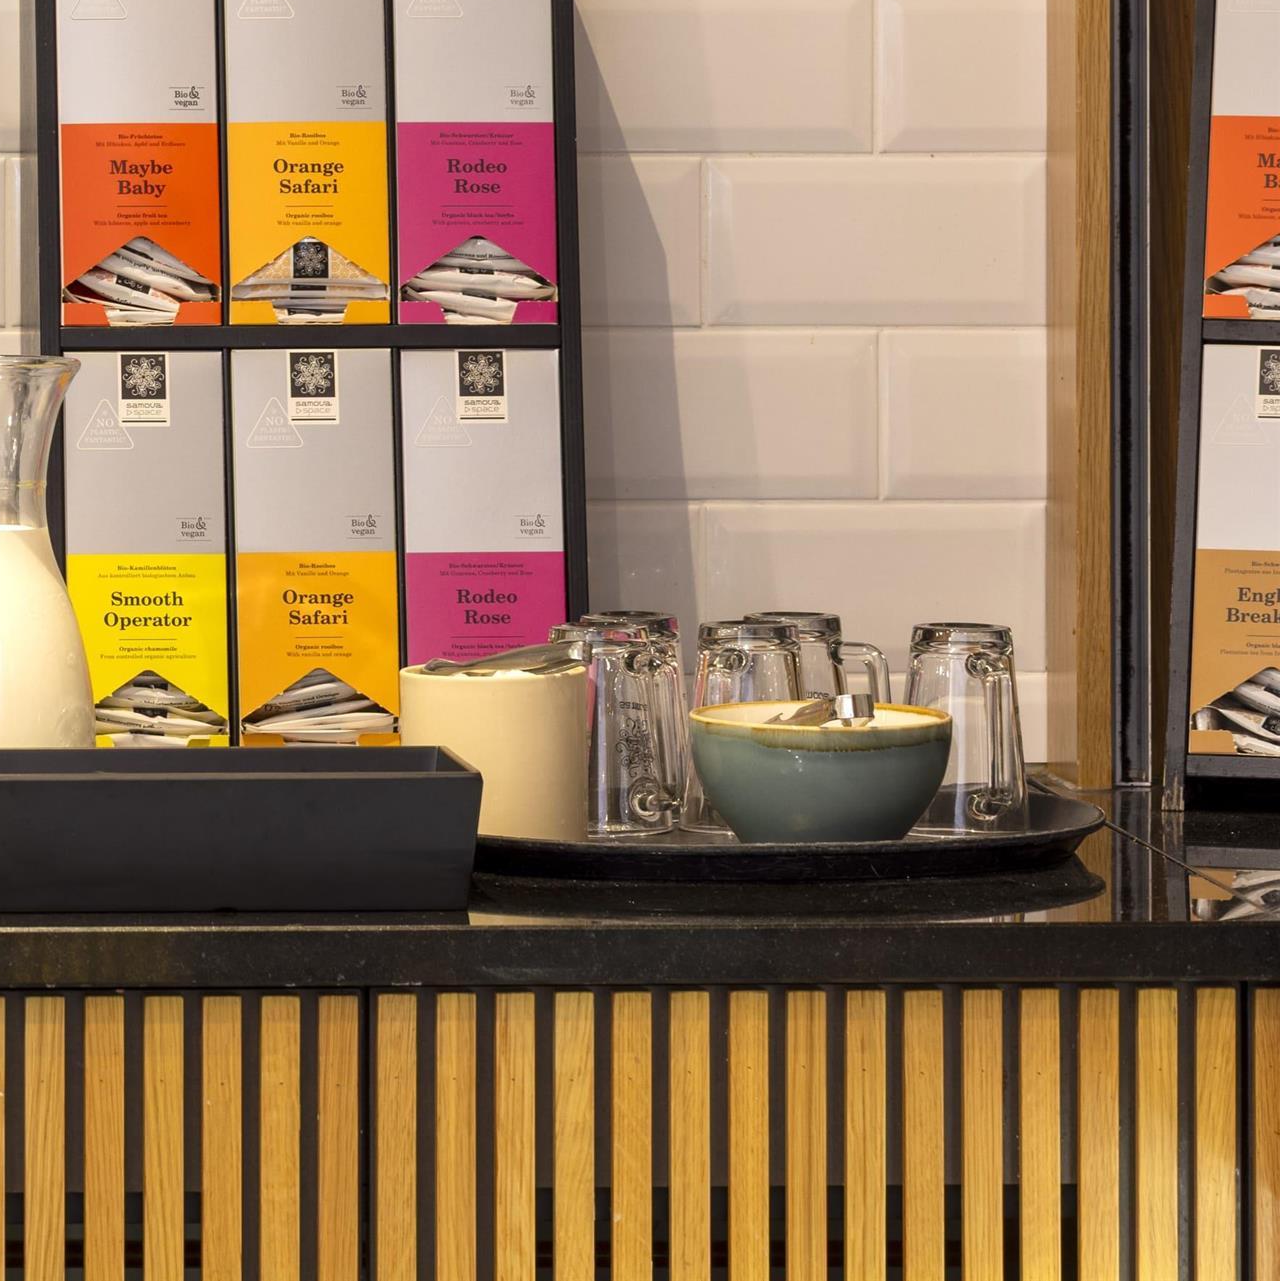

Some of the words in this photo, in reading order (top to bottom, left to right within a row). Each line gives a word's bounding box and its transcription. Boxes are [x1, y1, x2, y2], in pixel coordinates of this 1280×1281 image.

[110, 160, 173, 177] Maybe
[274, 159, 344, 176] Orange
[447, 159, 507, 173] Rodeo
[118, 180, 166, 197] Baby
[280, 179, 338, 193] Safari
[454, 179, 501, 193] Rose
[111, 591, 183, 606] Smooth
[283, 590, 353, 607] Orange
[456, 589, 517, 604] Rodeo
[104, 612, 192, 630] Operator
[289, 610, 348, 625] Safari
[464, 610, 511, 624] Rose
